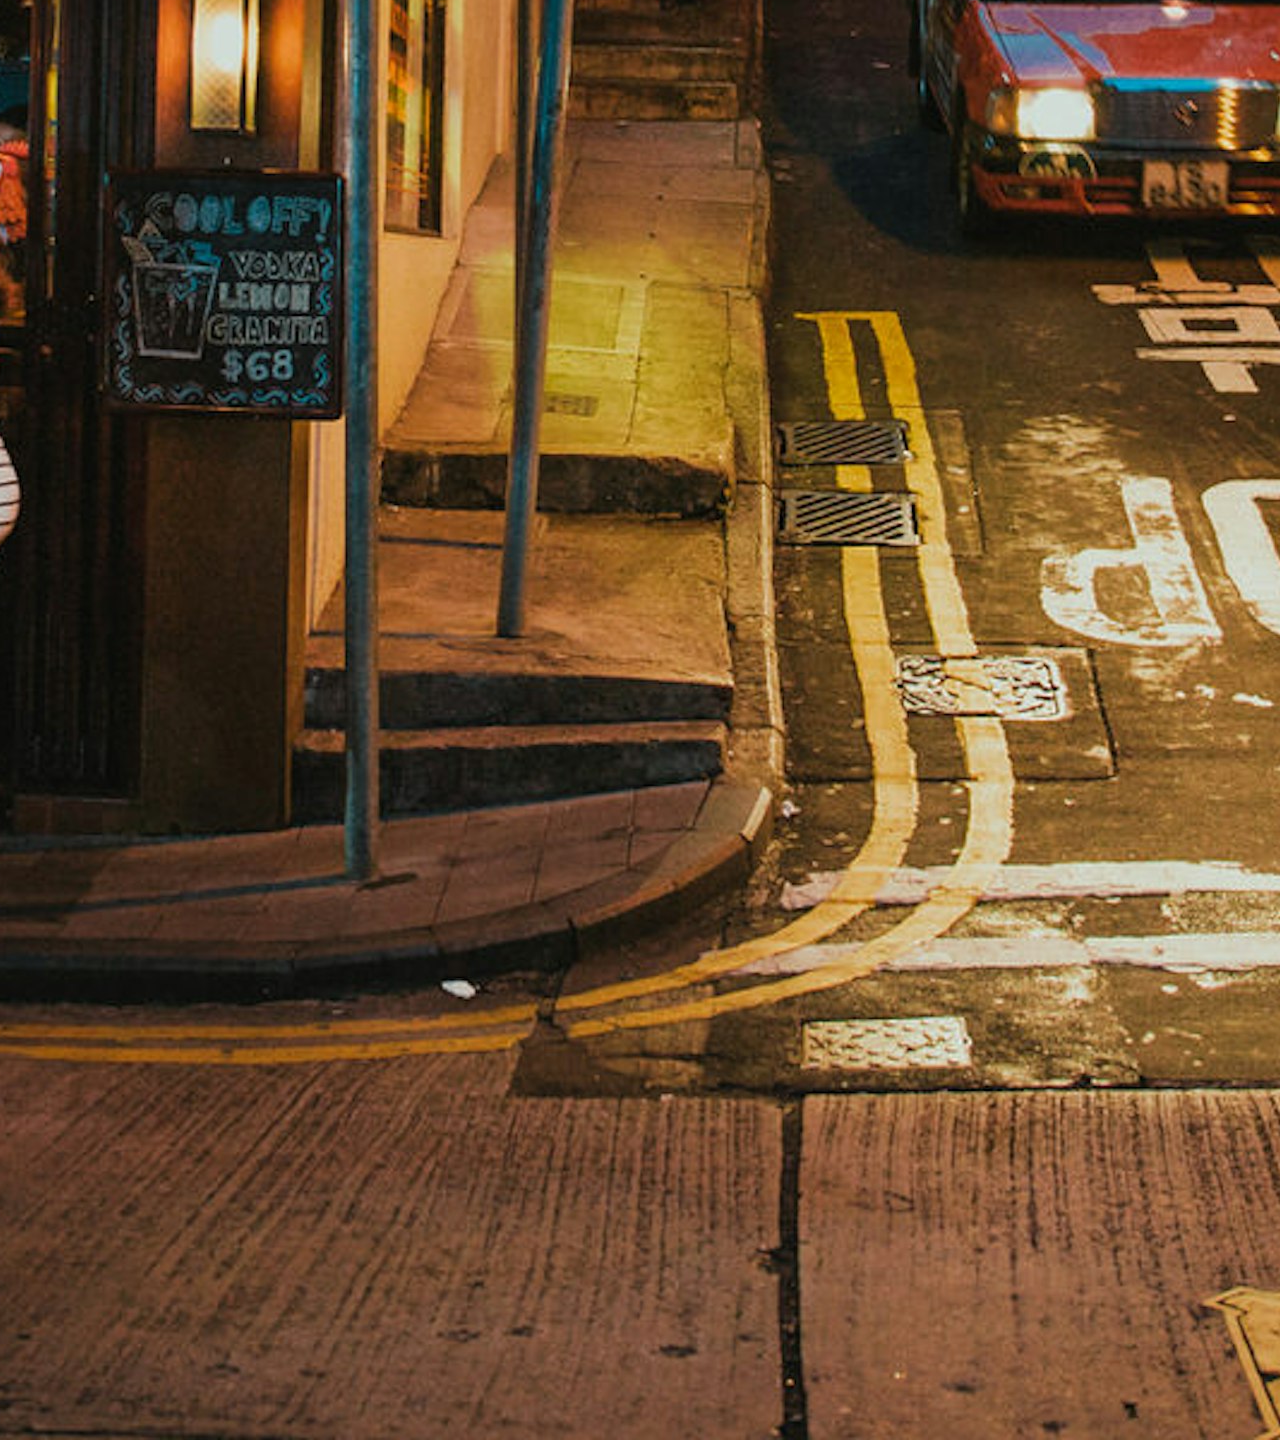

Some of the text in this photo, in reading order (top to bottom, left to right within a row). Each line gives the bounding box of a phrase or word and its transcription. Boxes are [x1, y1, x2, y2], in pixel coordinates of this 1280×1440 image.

[146, 193, 244, 235] COOL
[228, 251, 320, 280] VODKA
[219, 282, 311, 312] LEMON
[207, 315, 329, 345] GRANITA
[222, 349, 295, 384] $68
